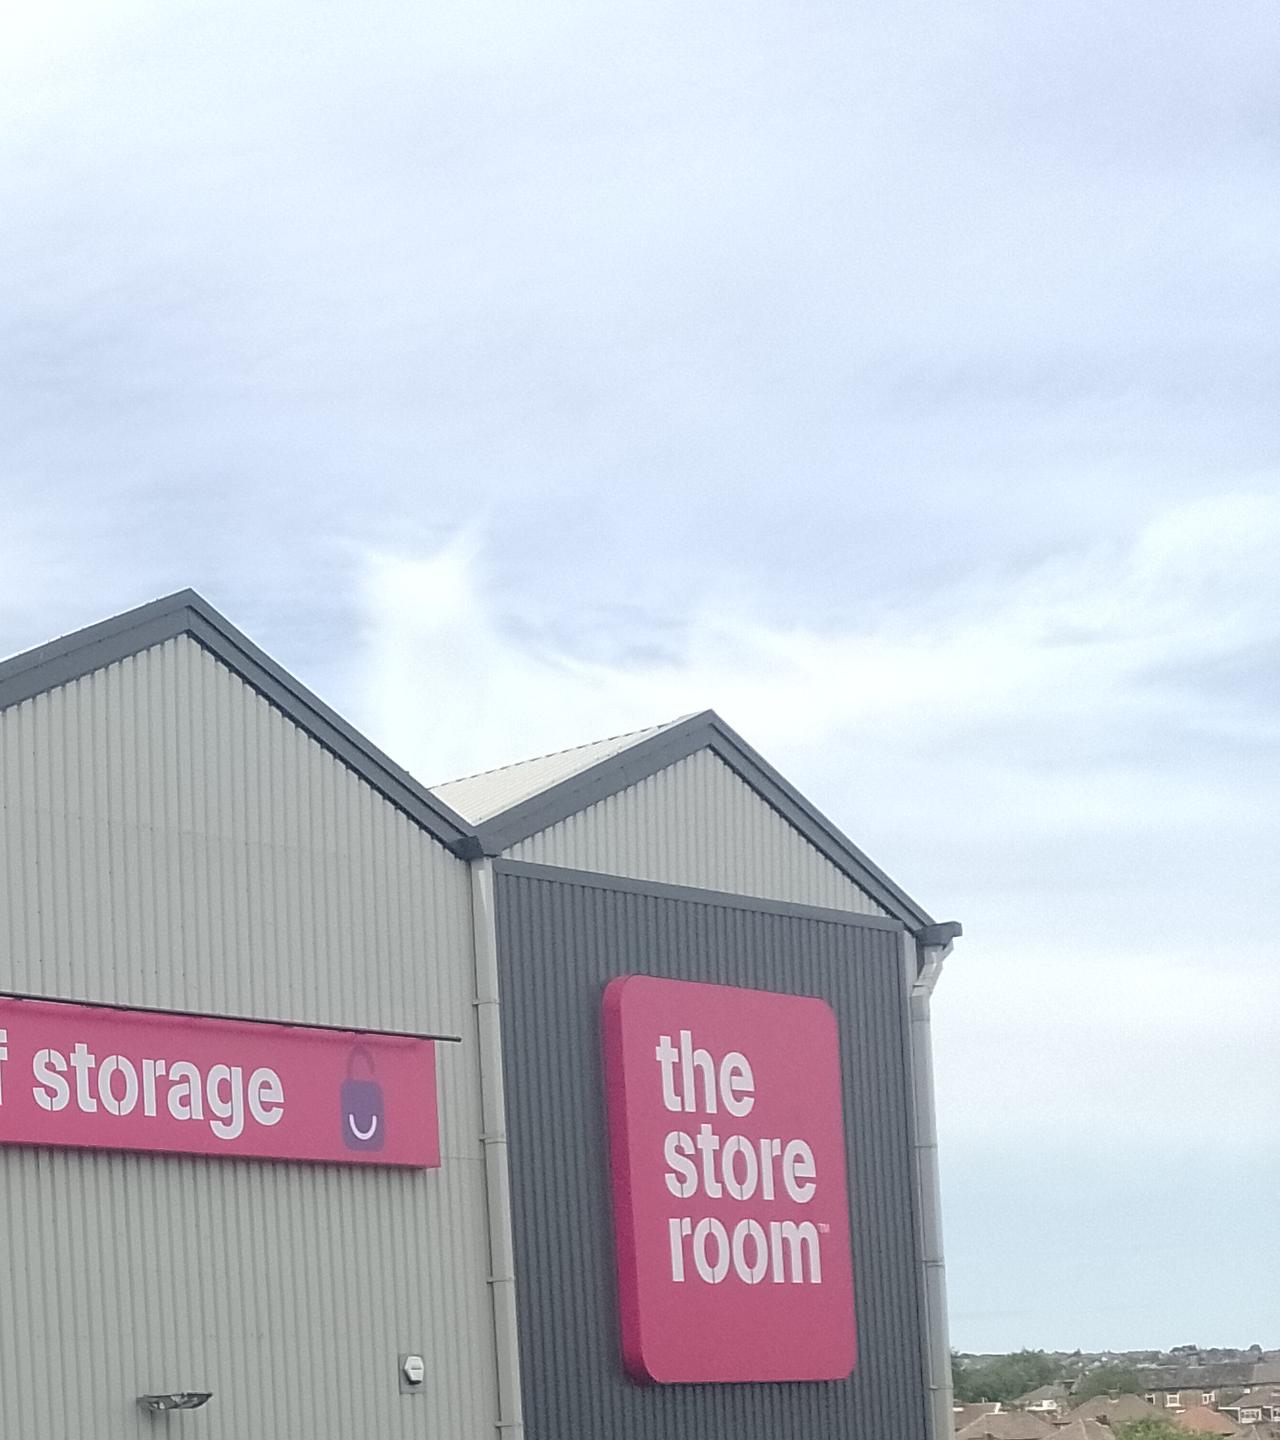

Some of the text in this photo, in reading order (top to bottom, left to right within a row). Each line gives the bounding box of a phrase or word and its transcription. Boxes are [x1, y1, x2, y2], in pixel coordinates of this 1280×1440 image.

[32, 1041, 285, 1140] storage
[656, 1030, 755, 1117] the
[664, 1123, 817, 1203] store
[669, 1216, 822, 1284] room
